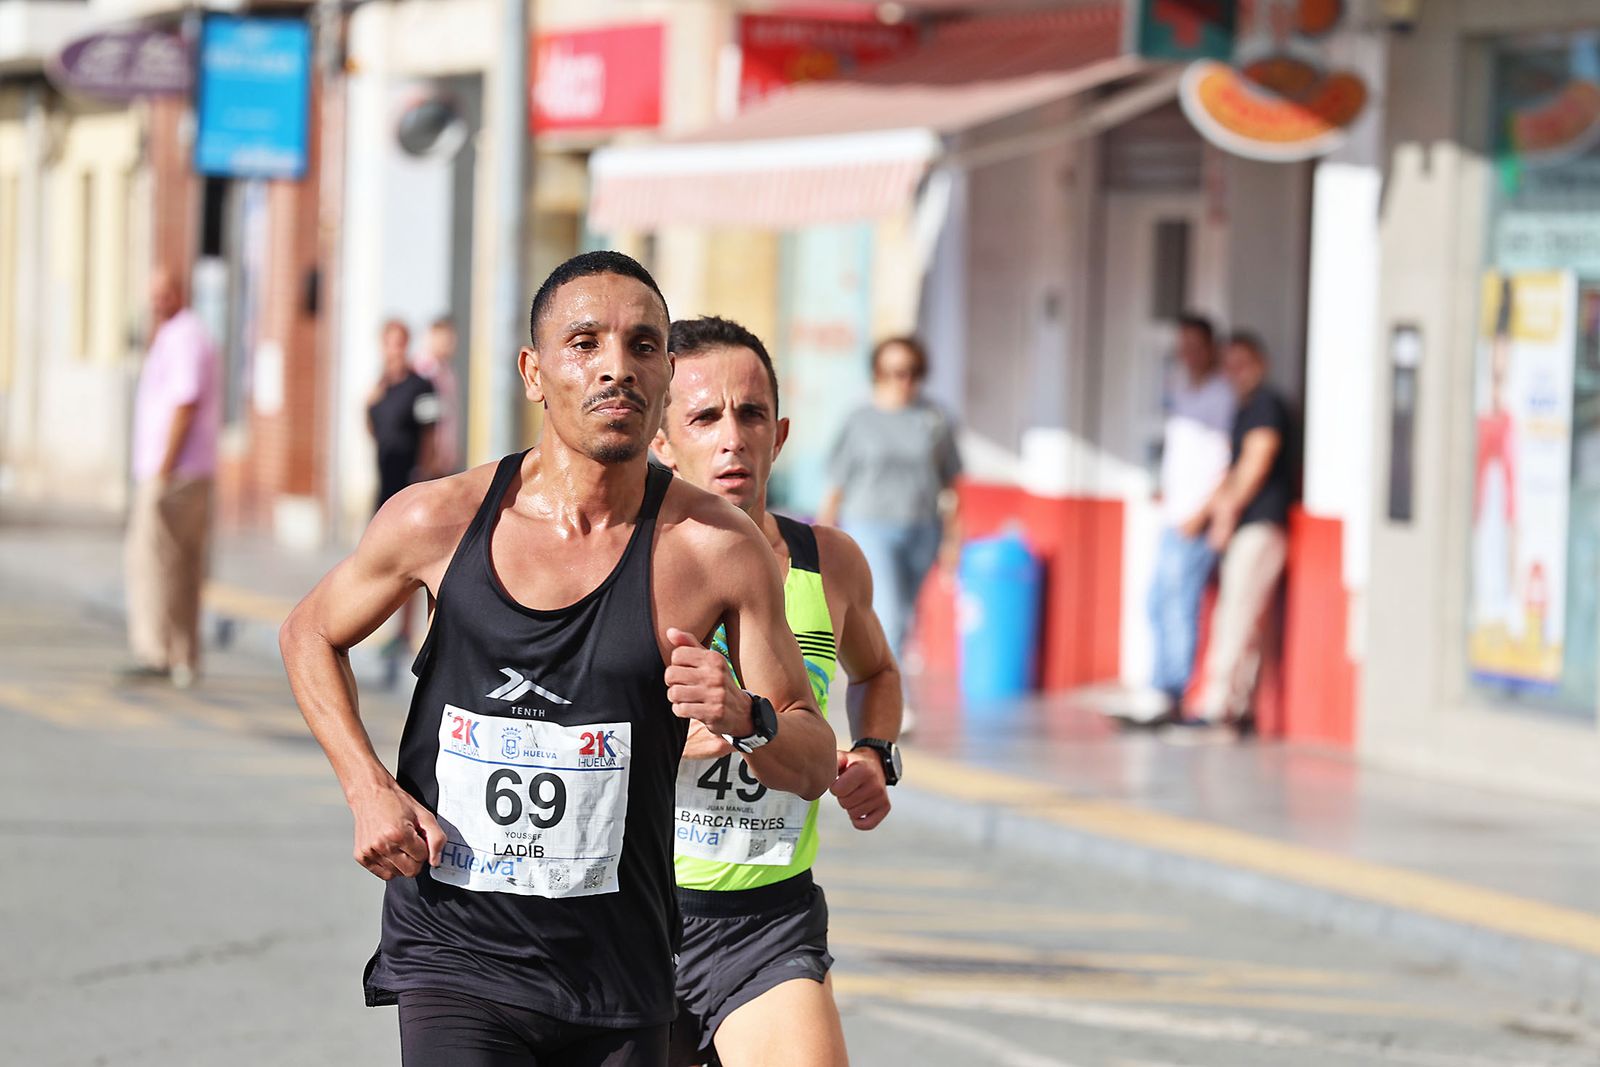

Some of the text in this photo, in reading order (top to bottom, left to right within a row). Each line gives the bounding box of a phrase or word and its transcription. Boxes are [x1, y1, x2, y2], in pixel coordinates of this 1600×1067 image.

[511, 706, 546, 718] TENTH
[451, 716, 480, 748] 21K
[451, 740, 480, 758] HUELVA
[579, 730, 617, 758] 21K
[523, 749, 558, 760] HUELVA
[578, 757, 617, 768] HUELVA
[697, 752, 768, 803] 49
[485, 768, 567, 829] 69
[725, 805, 754, 814] MANUEL
[738, 815, 785, 831] REYES
[504, 831, 543, 841] YOUSSEF
[676, 824, 719, 846] elva
[493, 843, 545, 859] LADIB
[441, 845, 515, 877] Huelva
